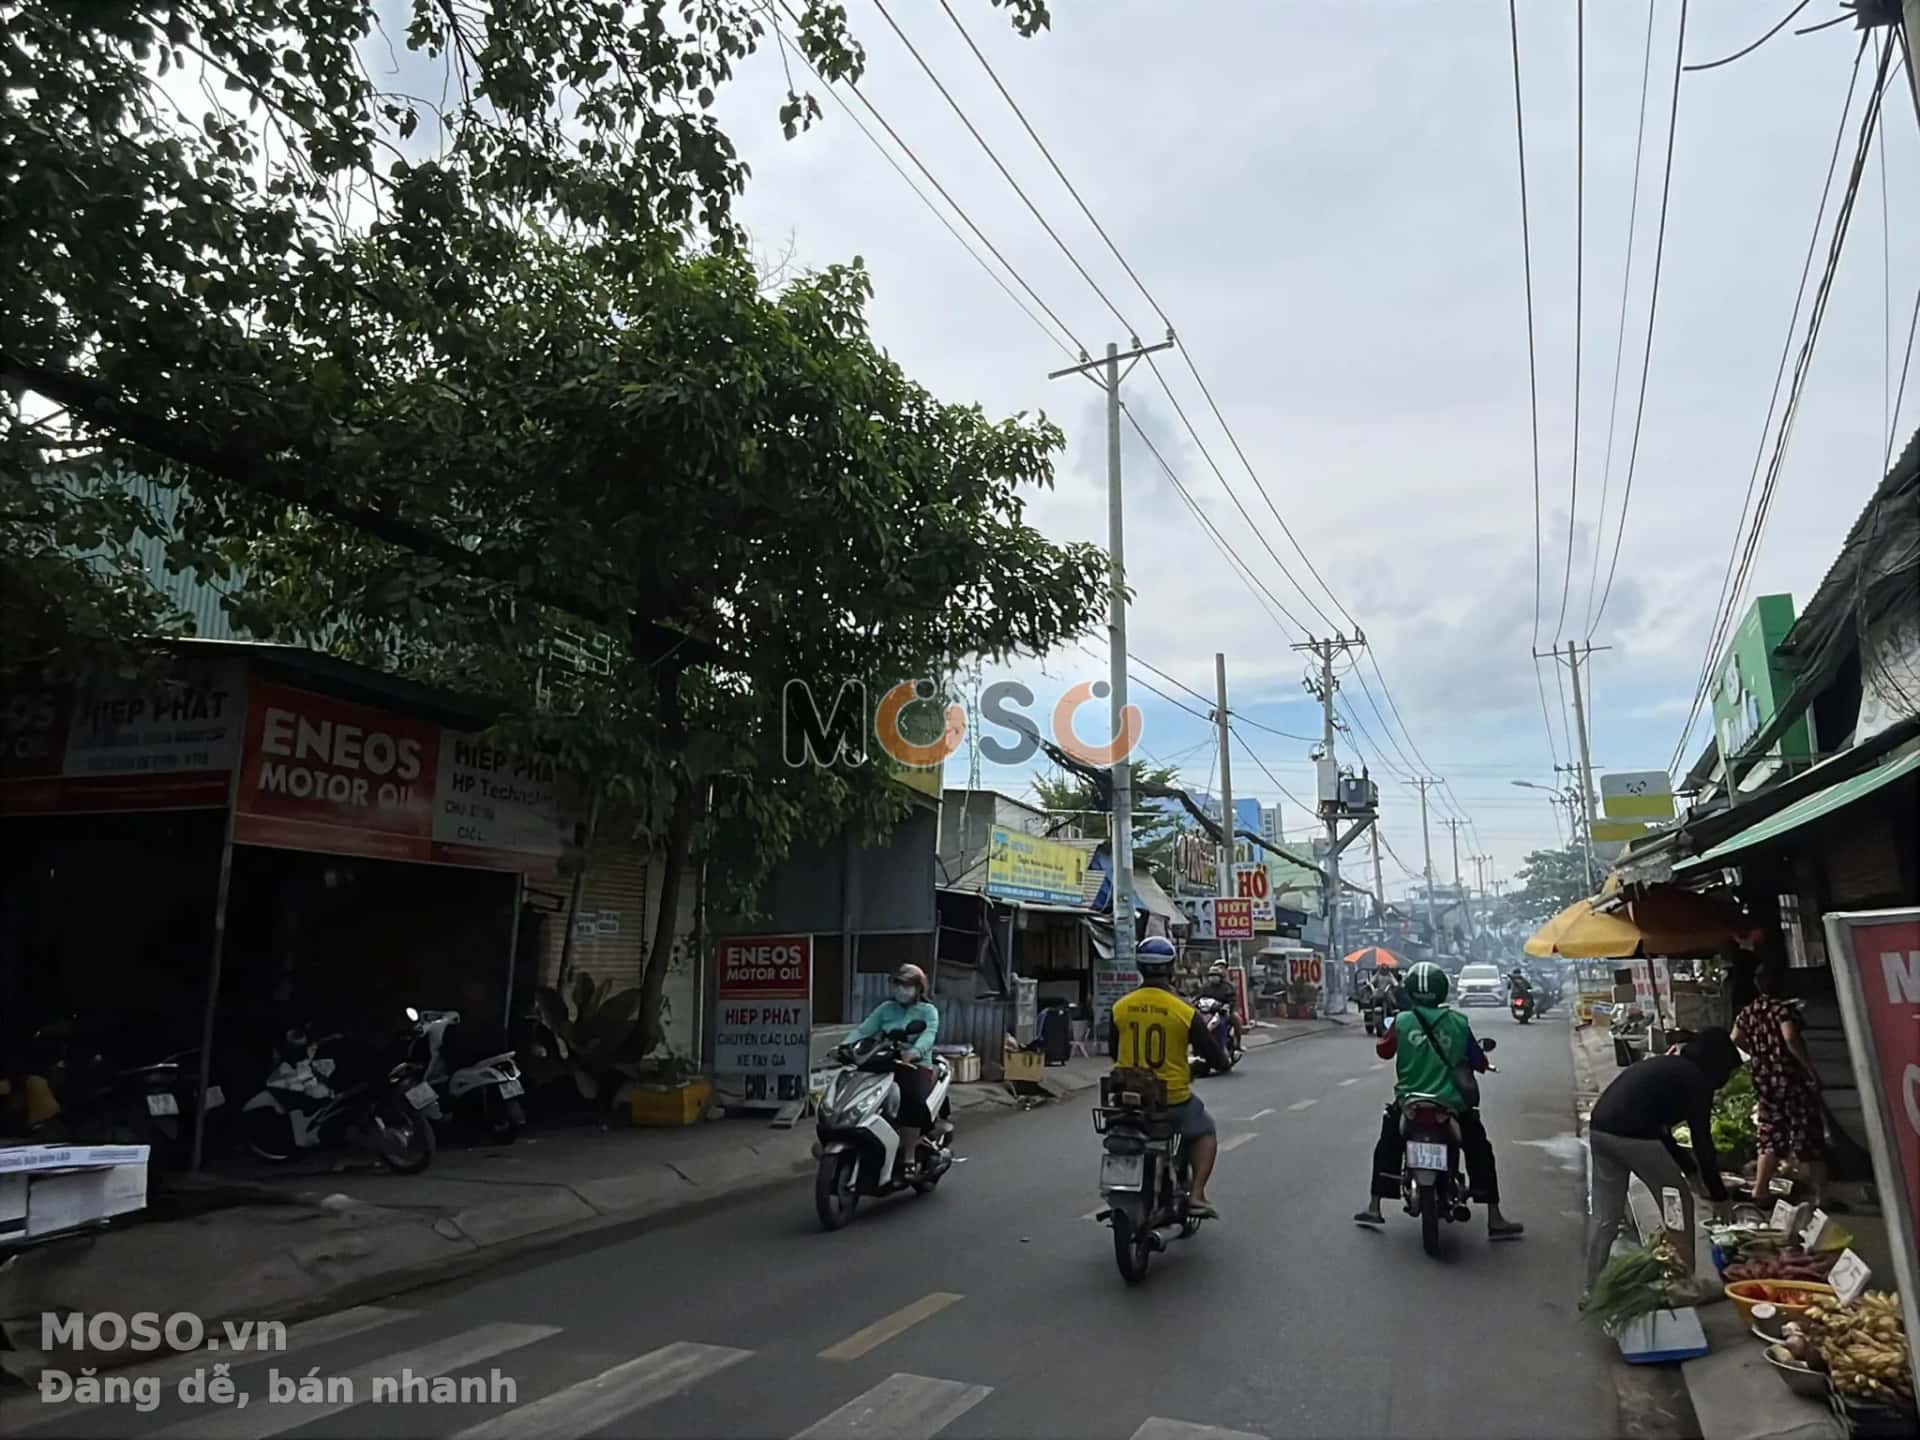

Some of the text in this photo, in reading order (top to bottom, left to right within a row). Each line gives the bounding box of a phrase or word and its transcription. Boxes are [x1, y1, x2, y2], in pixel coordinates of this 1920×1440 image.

[261, 706, 422, 780] ENEOS
[257, 760, 369, 808] MOTOR
[726, 945, 802, 968] ENEOS
[726, 967, 803, 982] MOTOR OIL
[1129, 1021, 1167, 1069] 10
